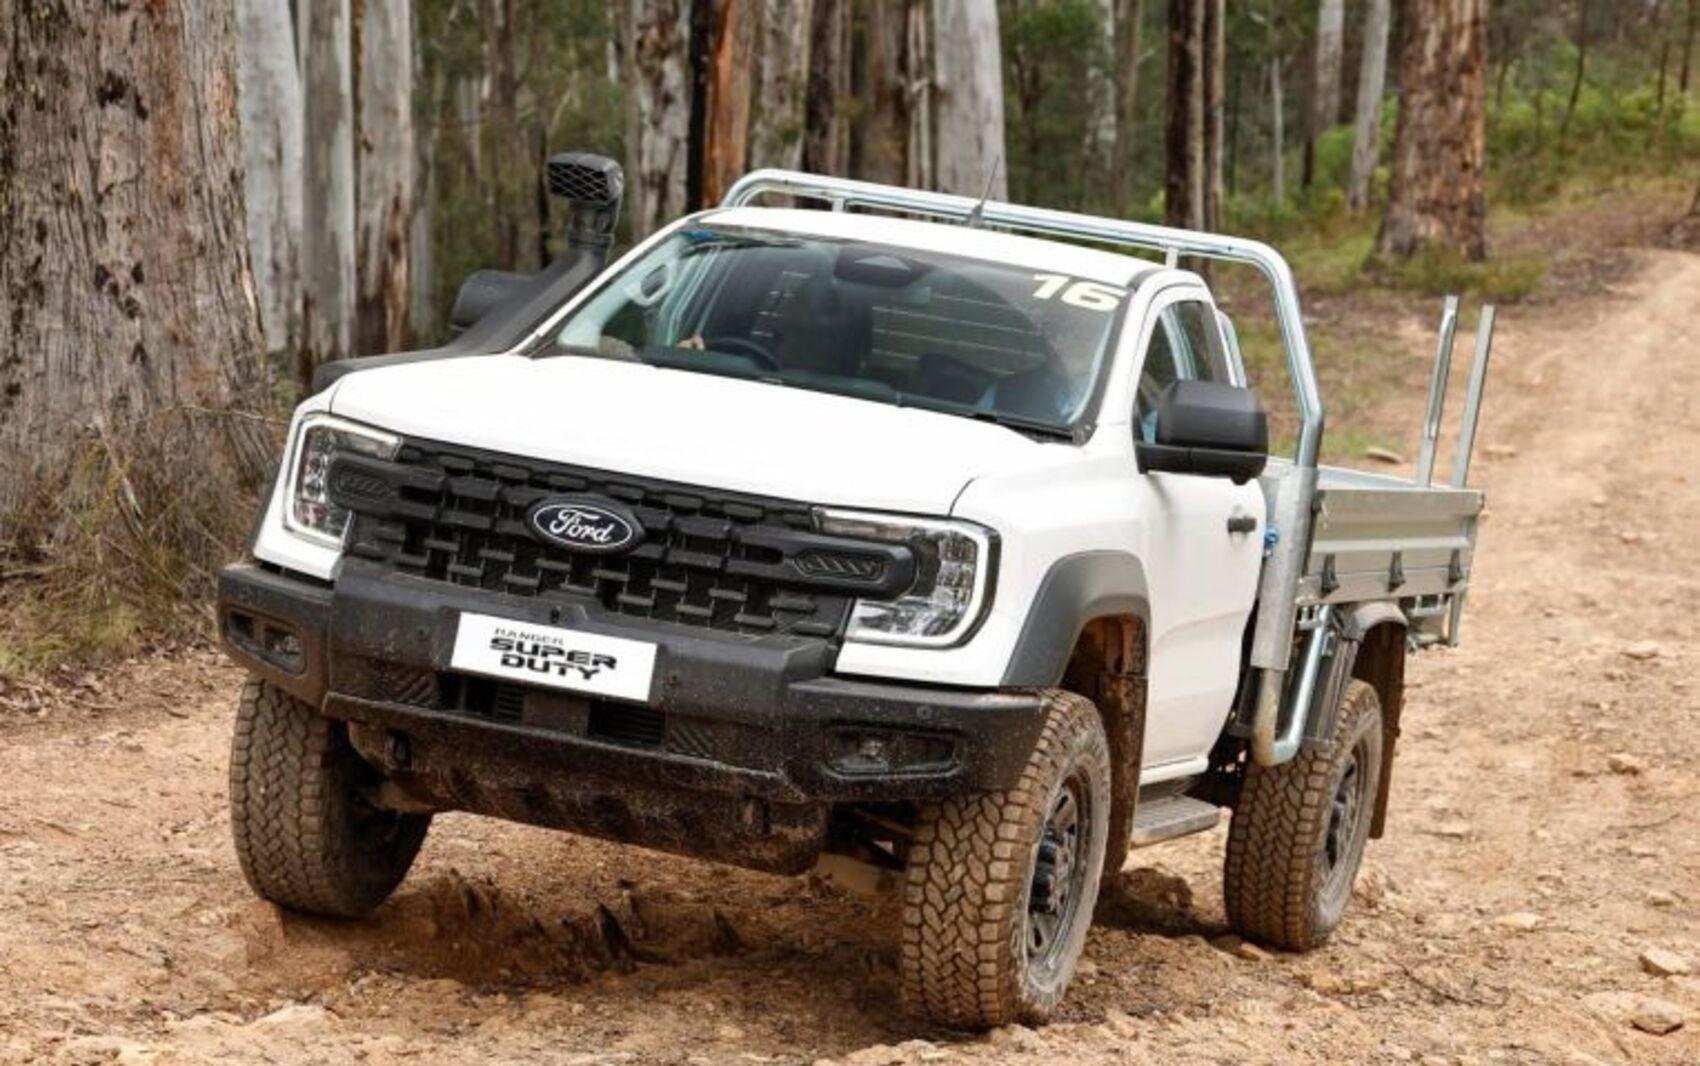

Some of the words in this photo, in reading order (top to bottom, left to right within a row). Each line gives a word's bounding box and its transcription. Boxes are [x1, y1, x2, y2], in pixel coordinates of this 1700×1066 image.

[1032, 273, 1129, 311] 16
[550, 509, 614, 542] Ford
[494, 627, 563, 645] RANGER
[489, 637, 617, 670] SUPER
[500, 653, 600, 681] DUTY
